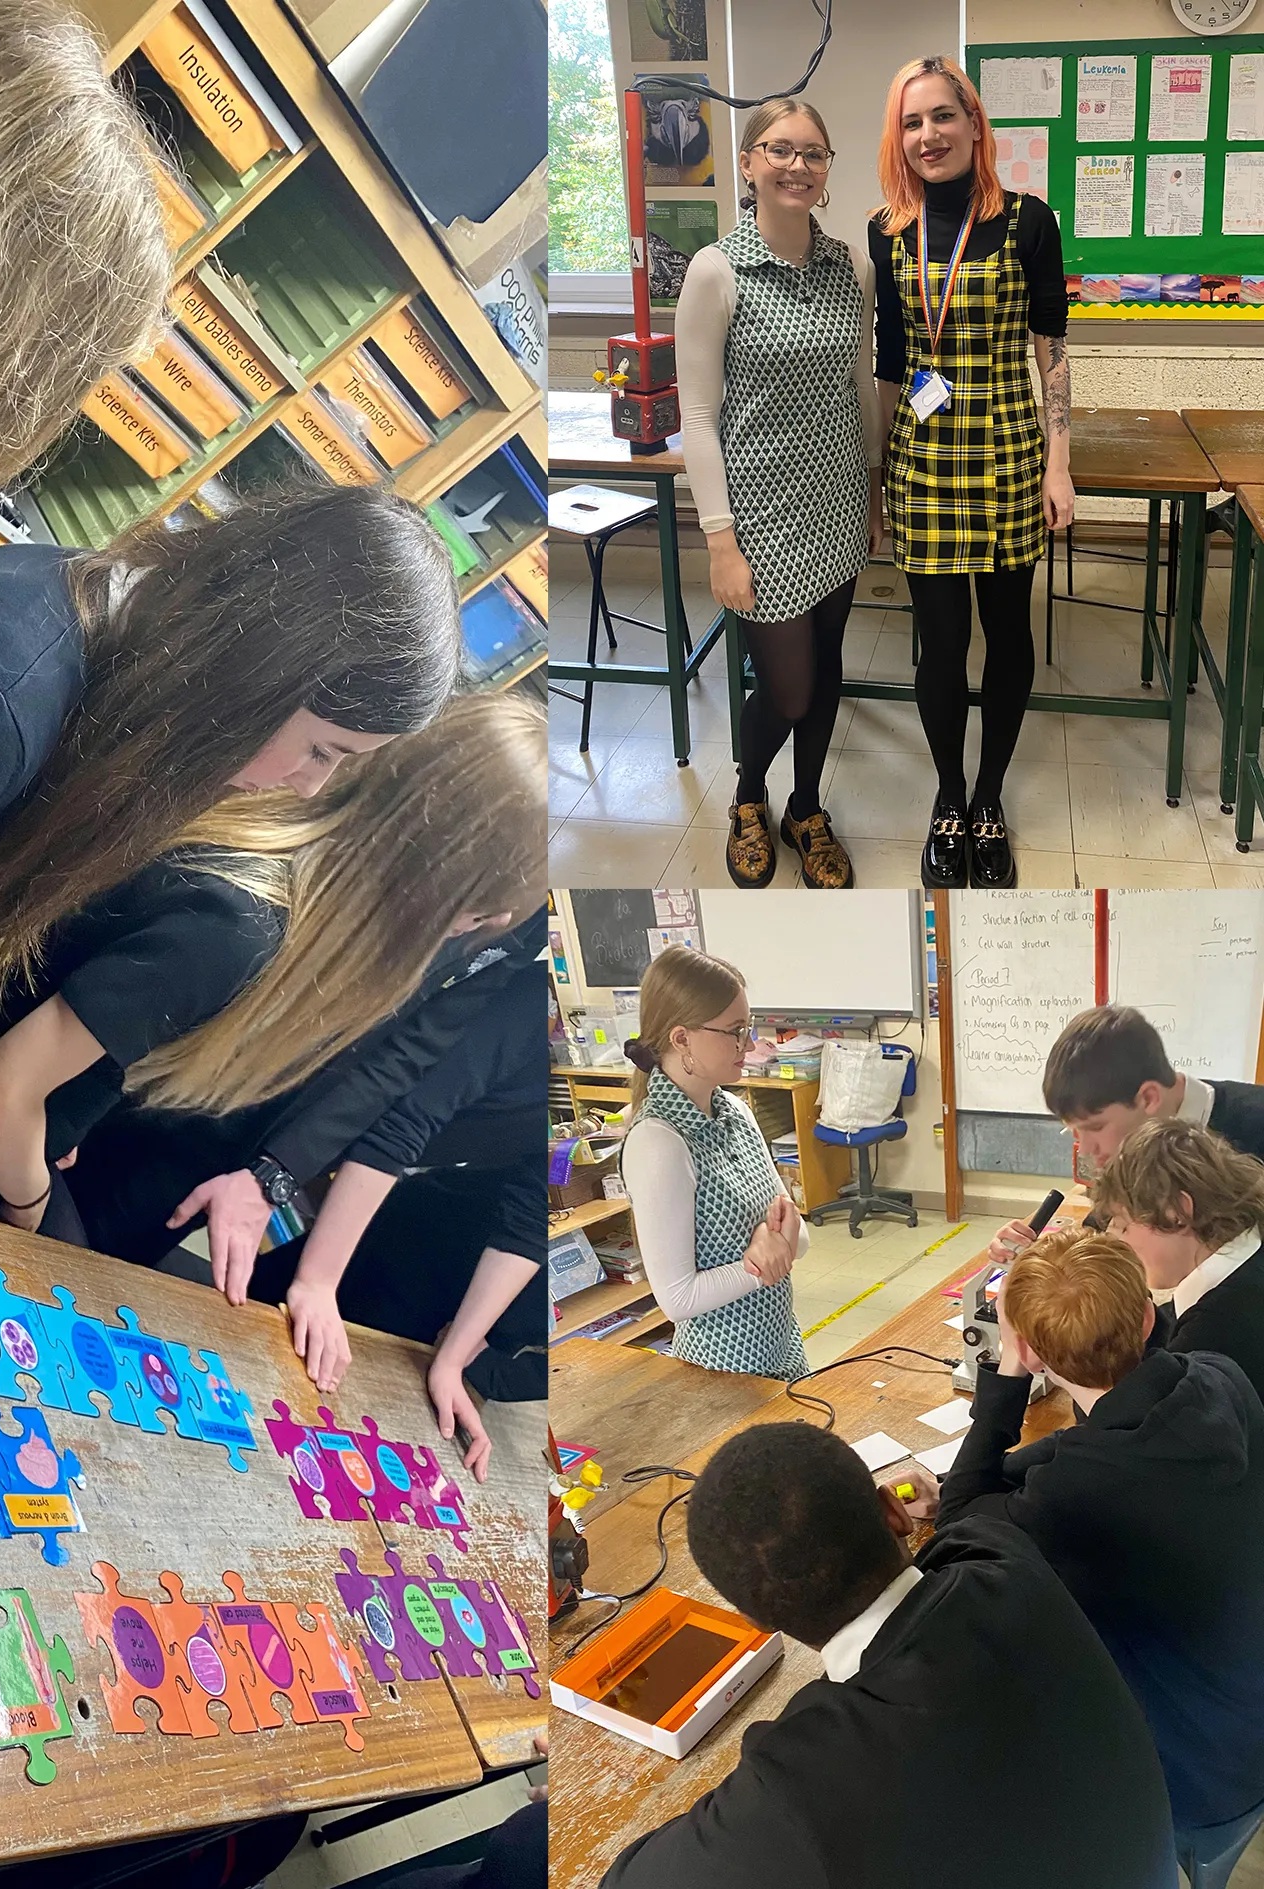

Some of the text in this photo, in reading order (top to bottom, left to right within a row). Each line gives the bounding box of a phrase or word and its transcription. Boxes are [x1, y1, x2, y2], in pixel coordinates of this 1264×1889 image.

[1083, 62, 1127, 75] Leukemia
[178, 44, 243, 133] Insulation
[1091, 156, 1118, 167] Bone
[205, 317, 244, 360] babies
[239, 357, 272, 393] demo
[404, 326, 457, 388] Science Kits
[163, 357, 192, 392] Wire
[343, 376, 398, 438] Thermistors
[95, 385, 160, 452] Science Kits
[297, 411, 362, 481] Sonar Explorer
[1051, 909, 1061, 922] of
[1063, 911, 1079, 921] cell
[971, 967, 1011, 985] Period 7
[971, 995, 1033, 1013] Magnification
[1039, 995, 1082, 1009] explanation
[1022, 1021, 1031, 1029] on
[1035, 1020, 1050, 1035] page
[1197, 1056, 1212, 1067] the
[26, 1496, 49, 1507] system
[18, 1512, 43, 1520] nervous
[50, 1512, 69, 1522] Brain
[120, 1619, 144, 1630] move
[131, 1638, 144, 1649] me
[131, 1654, 158, 1673] Helps
[322, 1695, 349, 1709] Muscle
[9, 1711, 38, 1731] Blood
